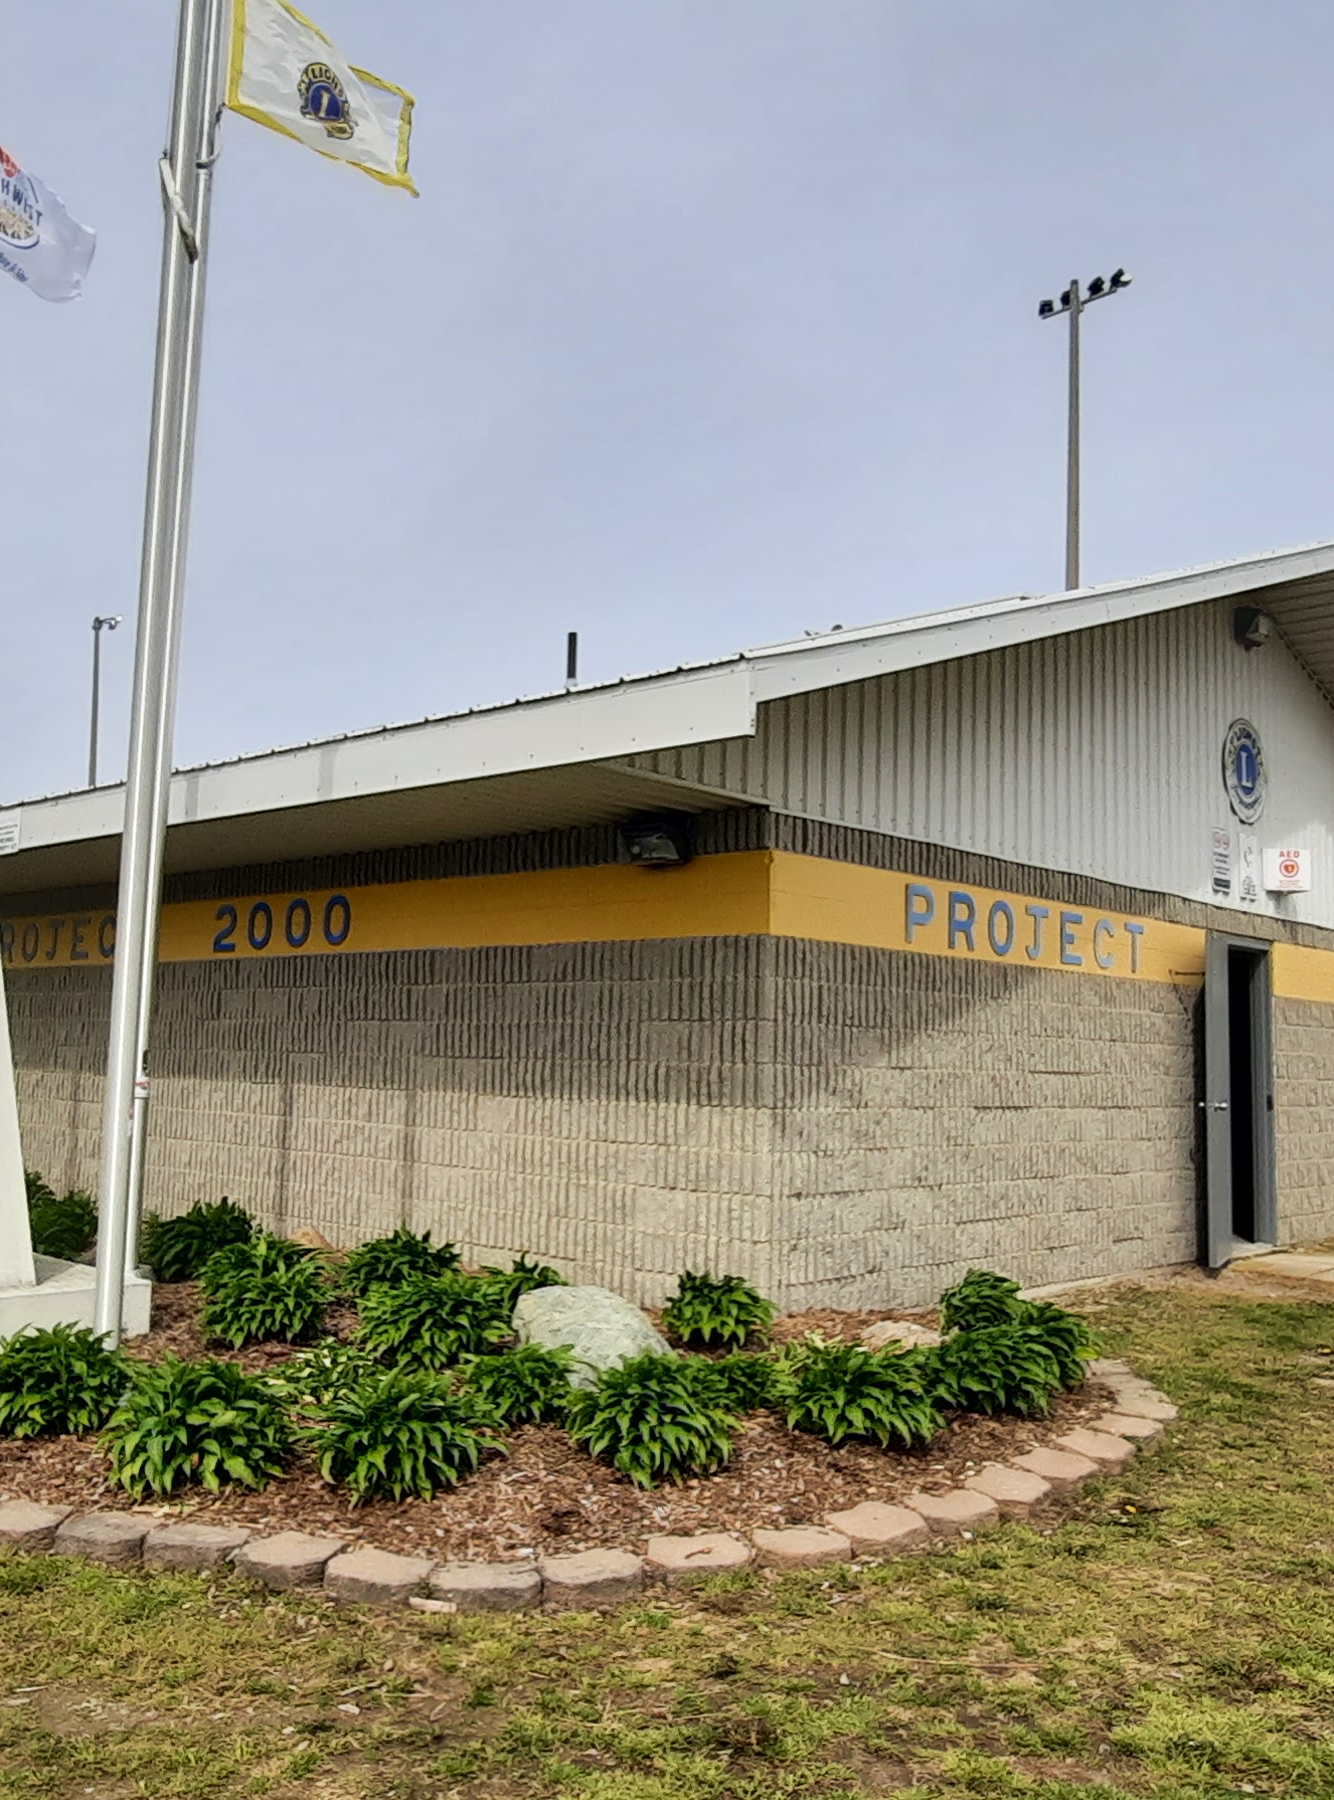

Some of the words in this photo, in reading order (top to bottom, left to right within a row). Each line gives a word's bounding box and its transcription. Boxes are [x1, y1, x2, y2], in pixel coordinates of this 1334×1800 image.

[1240, 751, 1254, 788] L
[1278, 850, 1301, 859] AED
[0, 914, 117, 964] ROJEC
[213, 893, 352, 953] 2000
[904, 883, 1145, 974] PROJECT
